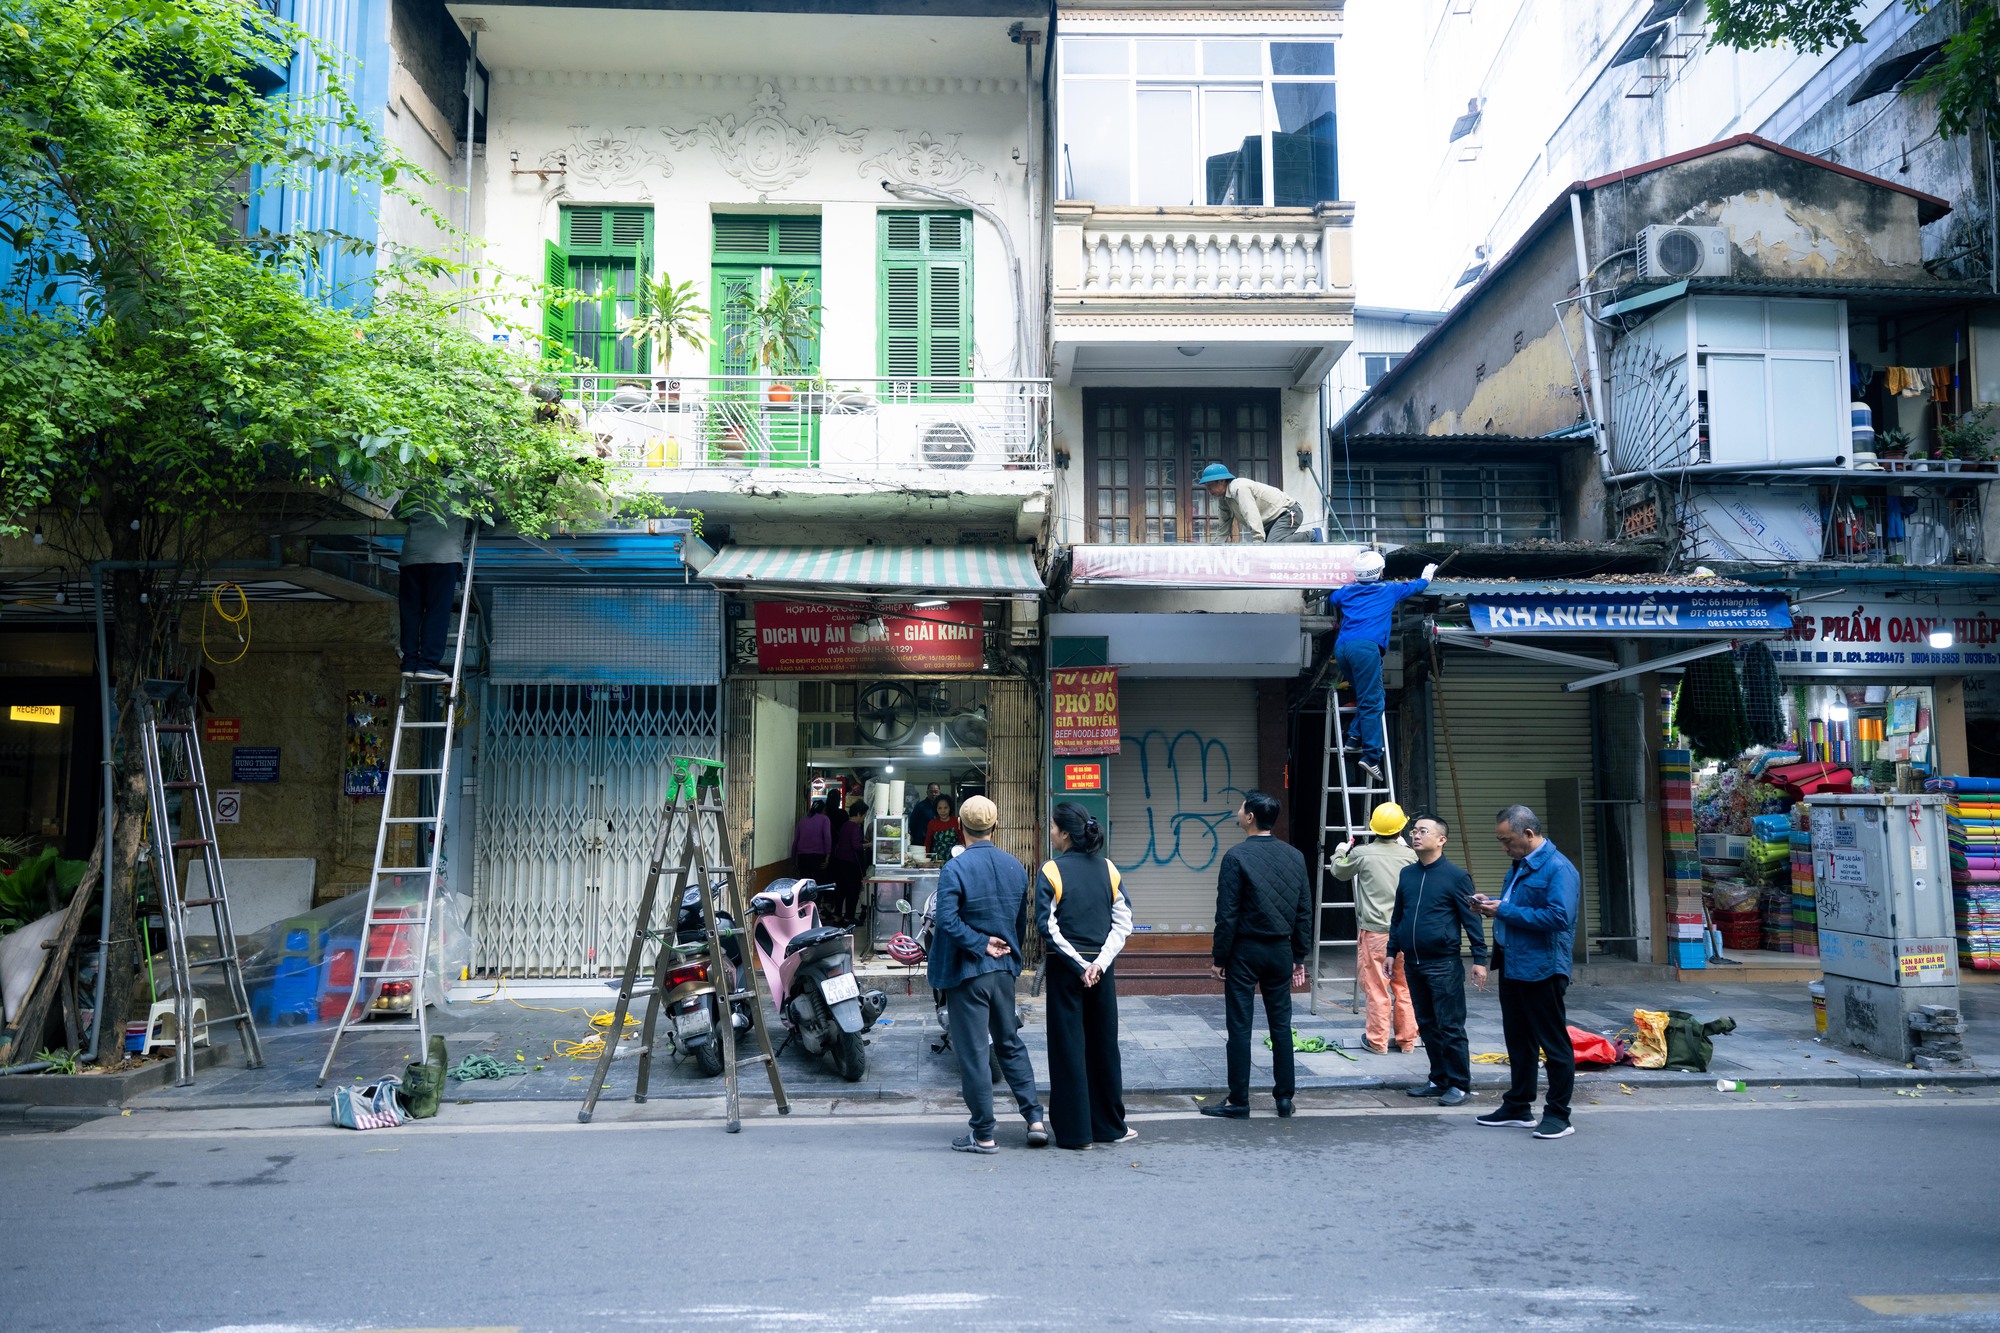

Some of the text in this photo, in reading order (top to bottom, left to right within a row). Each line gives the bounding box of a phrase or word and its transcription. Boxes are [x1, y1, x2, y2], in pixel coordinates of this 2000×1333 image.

[1712, 247, 1725, 255] LG
[1709, 598, 1720, 606] 66
[1722, 598, 1744, 608] Hàng
[1746, 597, 1760, 606] Mã
[728, 604, 742, 617] 68
[786, 605, 804, 615] HỢP
[806, 603, 824, 613] TÁC
[1488, 596, 1680, 628] KHANH HIỀN
[1690, 609, 1767, 618] ĐT: 0915 565 365
[1821, 604, 1882, 643] PHẨM
[1888, 617, 1947, 643] OAN
[762, 627, 798, 647] DỊCH
[801, 627, 820, 647] VỤ
[825, 623, 846, 643] ĂN
[904, 620, 934, 641] GIẢI
[938, 621, 975, 640] KHÁT
[827, 645, 844, 655] (MÃ
[847, 644, 882, 654] NGÀNH:
[1081, 669, 1115, 685] LÙN
[1055, 687, 1117, 713] PHỞ BÒ
[16, 705, 55, 716] RECEPTION
[1055, 712, 1117, 728] GIA TRUYỀN
[1055, 728, 1119, 738] BEEF NOODLE SOUP
[1914, 957, 1924, 965] BAY
